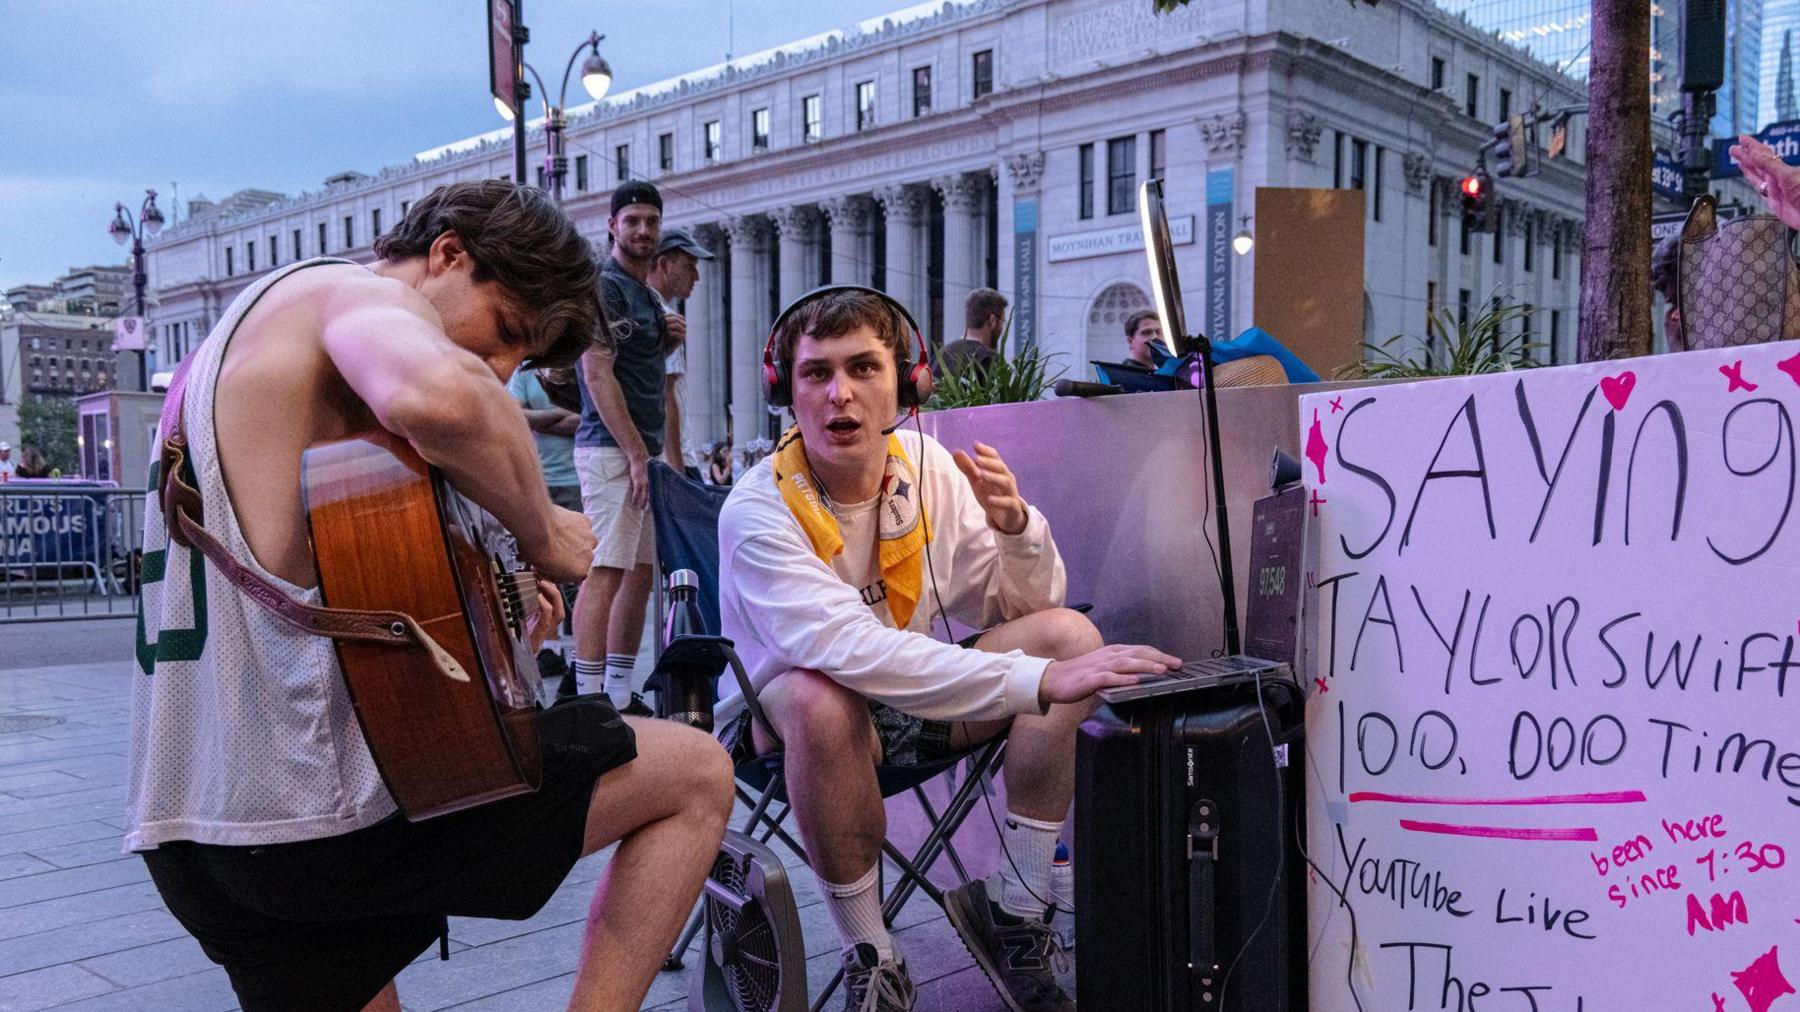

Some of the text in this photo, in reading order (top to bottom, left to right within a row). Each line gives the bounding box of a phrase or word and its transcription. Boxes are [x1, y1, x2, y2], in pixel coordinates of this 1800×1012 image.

[1021, 239, 1030, 272] HALL
[1052, 236, 1113, 253] MOYNIHAN
[1214, 211, 1225, 272] STATION
[1020, 276, 1030, 315] TRAIN
[1258, 565, 1286, 600] 97,548
[1649, 718, 1800, 807] Time
[1590, 814, 1727, 876] been here
[1608, 864, 1681, 909] since
